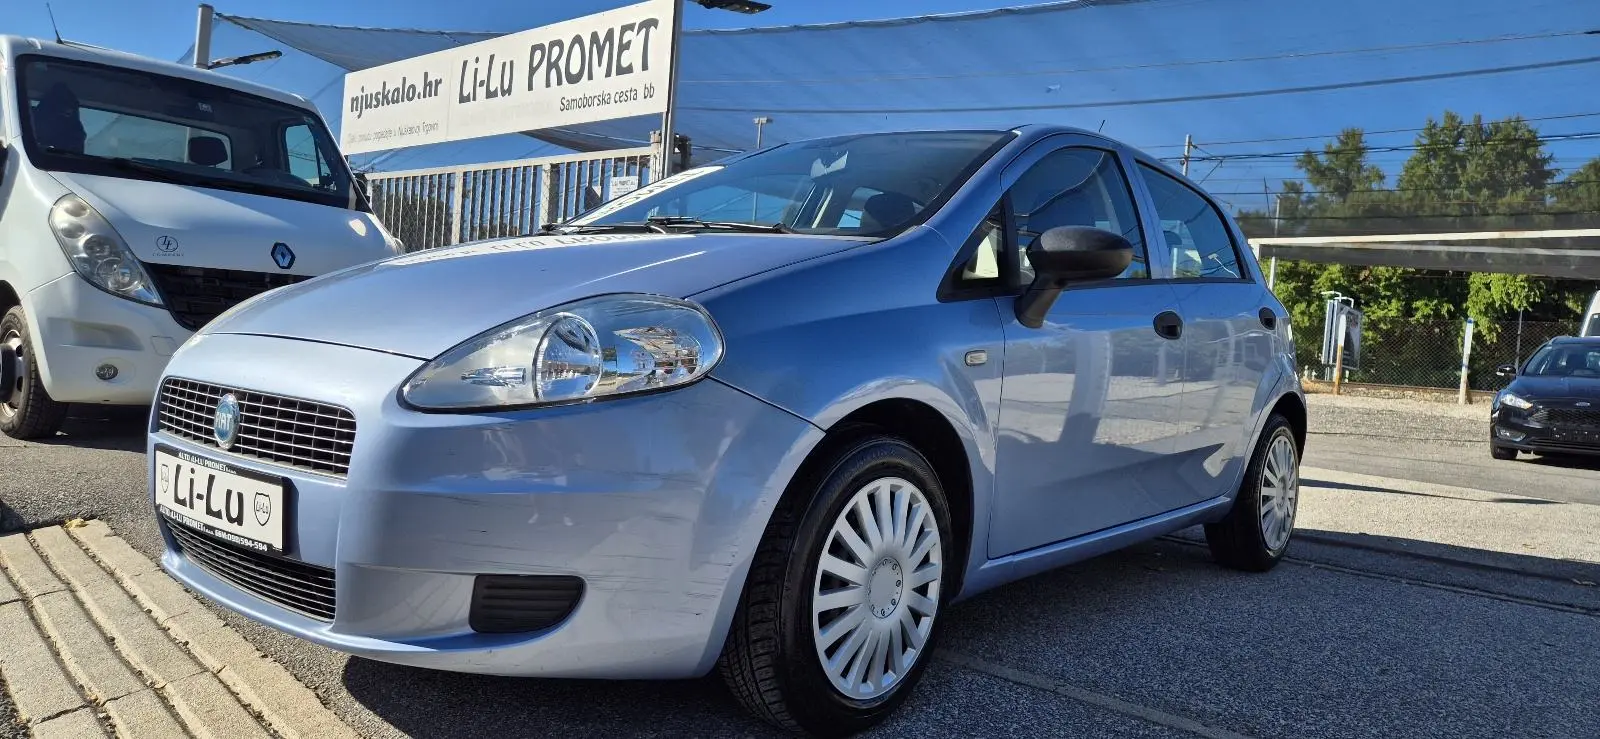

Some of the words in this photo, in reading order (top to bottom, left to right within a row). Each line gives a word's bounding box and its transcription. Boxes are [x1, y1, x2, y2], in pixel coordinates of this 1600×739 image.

[458, 54, 514, 104] Li-Lu
[527, 18, 659, 91] PROMET
[350, 71, 442, 119] njuskalo.hr
[560, 90, 611, 112] Samoborska
[614, 87, 638, 104] cesta
[643, 83, 655, 99] bb
[215, 411, 233, 430] FIAT
[174, 463, 244, 526] Li-Lu
